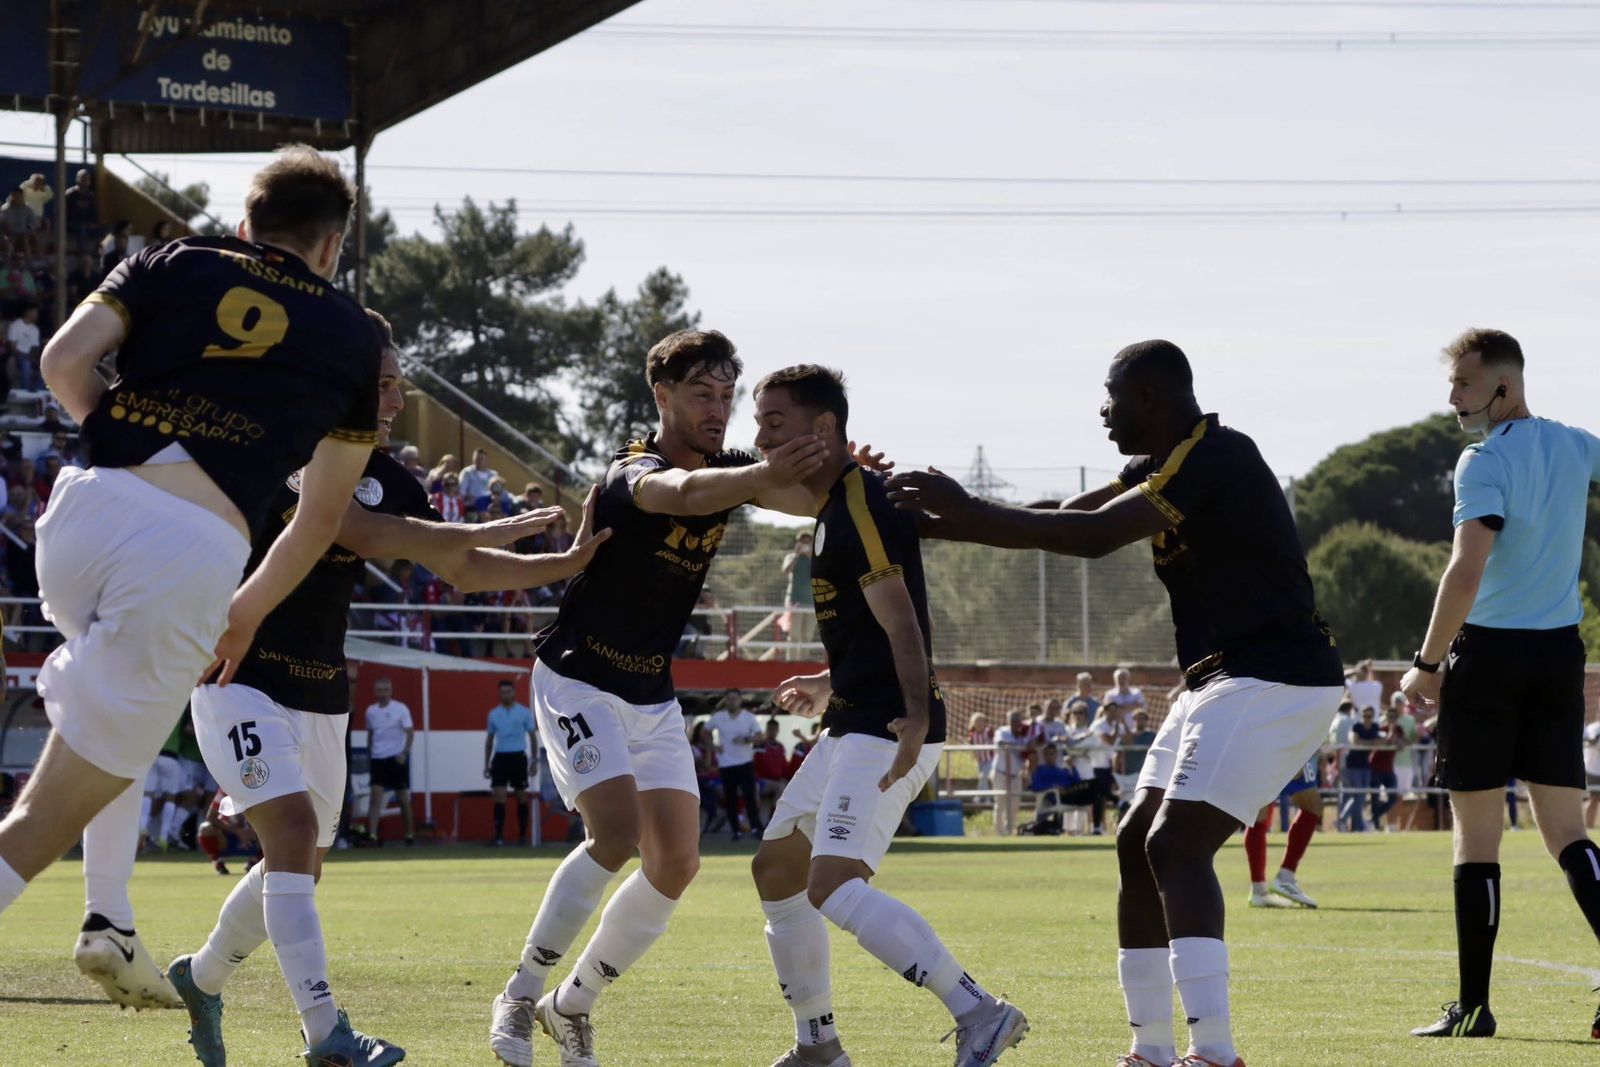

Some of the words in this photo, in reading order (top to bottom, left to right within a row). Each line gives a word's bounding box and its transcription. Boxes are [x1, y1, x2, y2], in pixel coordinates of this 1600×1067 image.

[202, 48, 231, 71] de
[158, 77, 276, 108] Tordesillas
[202, 286, 289, 358] 9
[183, 393, 265, 439] grupo
[228, 721, 262, 762] 15
[557, 712, 594, 750] 21
[1303, 762, 1316, 784] 18
